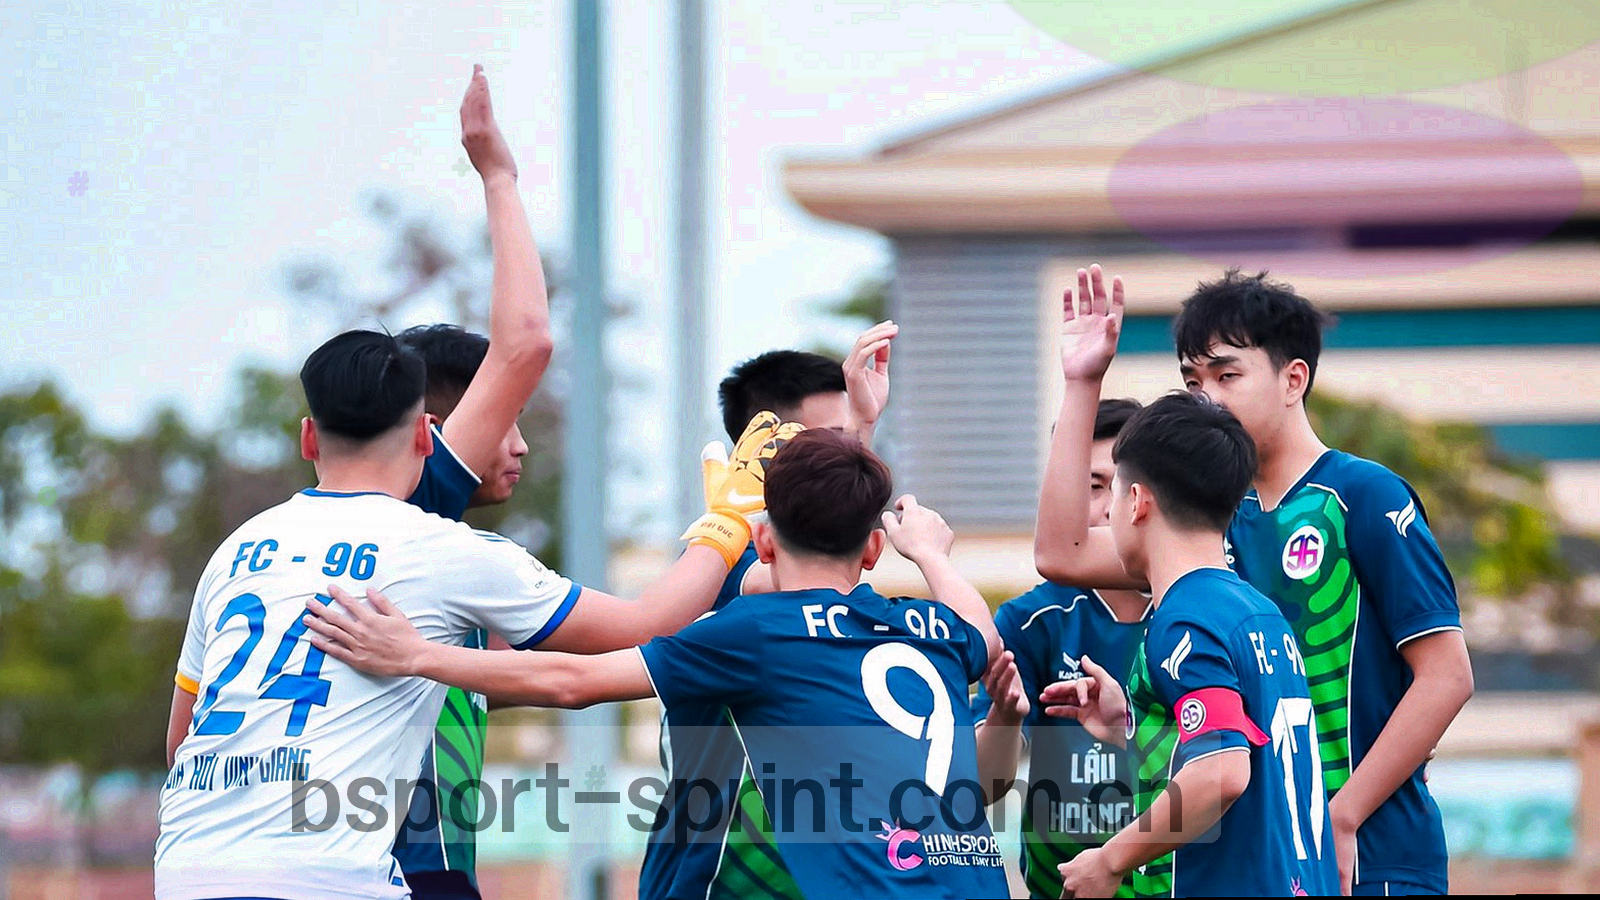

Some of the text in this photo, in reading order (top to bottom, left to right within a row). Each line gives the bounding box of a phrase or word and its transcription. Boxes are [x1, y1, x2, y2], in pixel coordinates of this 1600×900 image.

[229, 538, 279, 579] FC
[322, 541, 379, 581] 96
[1286, 533, 1319, 571] 96
[801, 603, 850, 639] FC
[904, 606, 951, 640] 96
[193, 592, 333, 738] 24
[1248, 631, 1275, 676] FC
[860, 642, 956, 797] 9
[259, 746, 312, 783] GIANG
[1070, 743, 1116, 784] LẨU
[1270, 697, 1324, 861] 17
